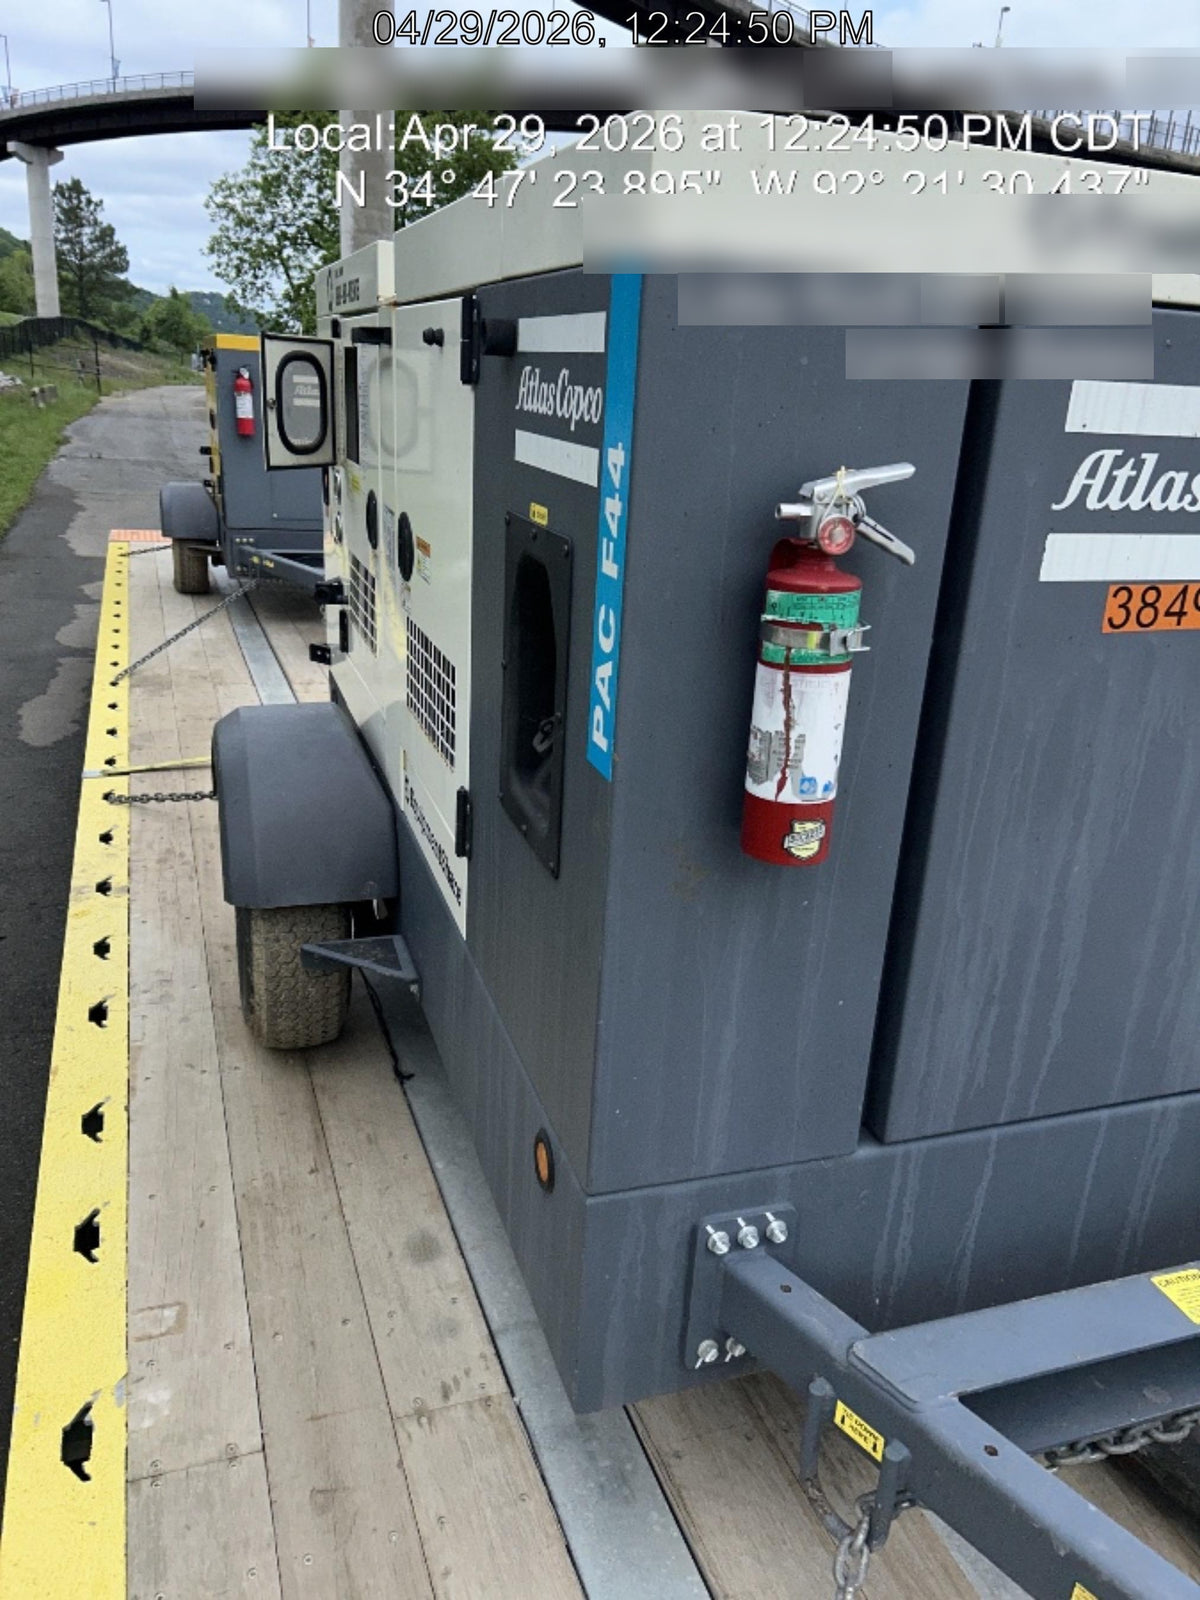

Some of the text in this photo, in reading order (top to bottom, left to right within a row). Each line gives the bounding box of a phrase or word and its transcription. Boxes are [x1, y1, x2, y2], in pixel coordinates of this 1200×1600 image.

[515, 365, 603, 431] Atlas Copco
[591, 442, 626, 752] PAC F44
[1107, 584, 1200, 630] 384
